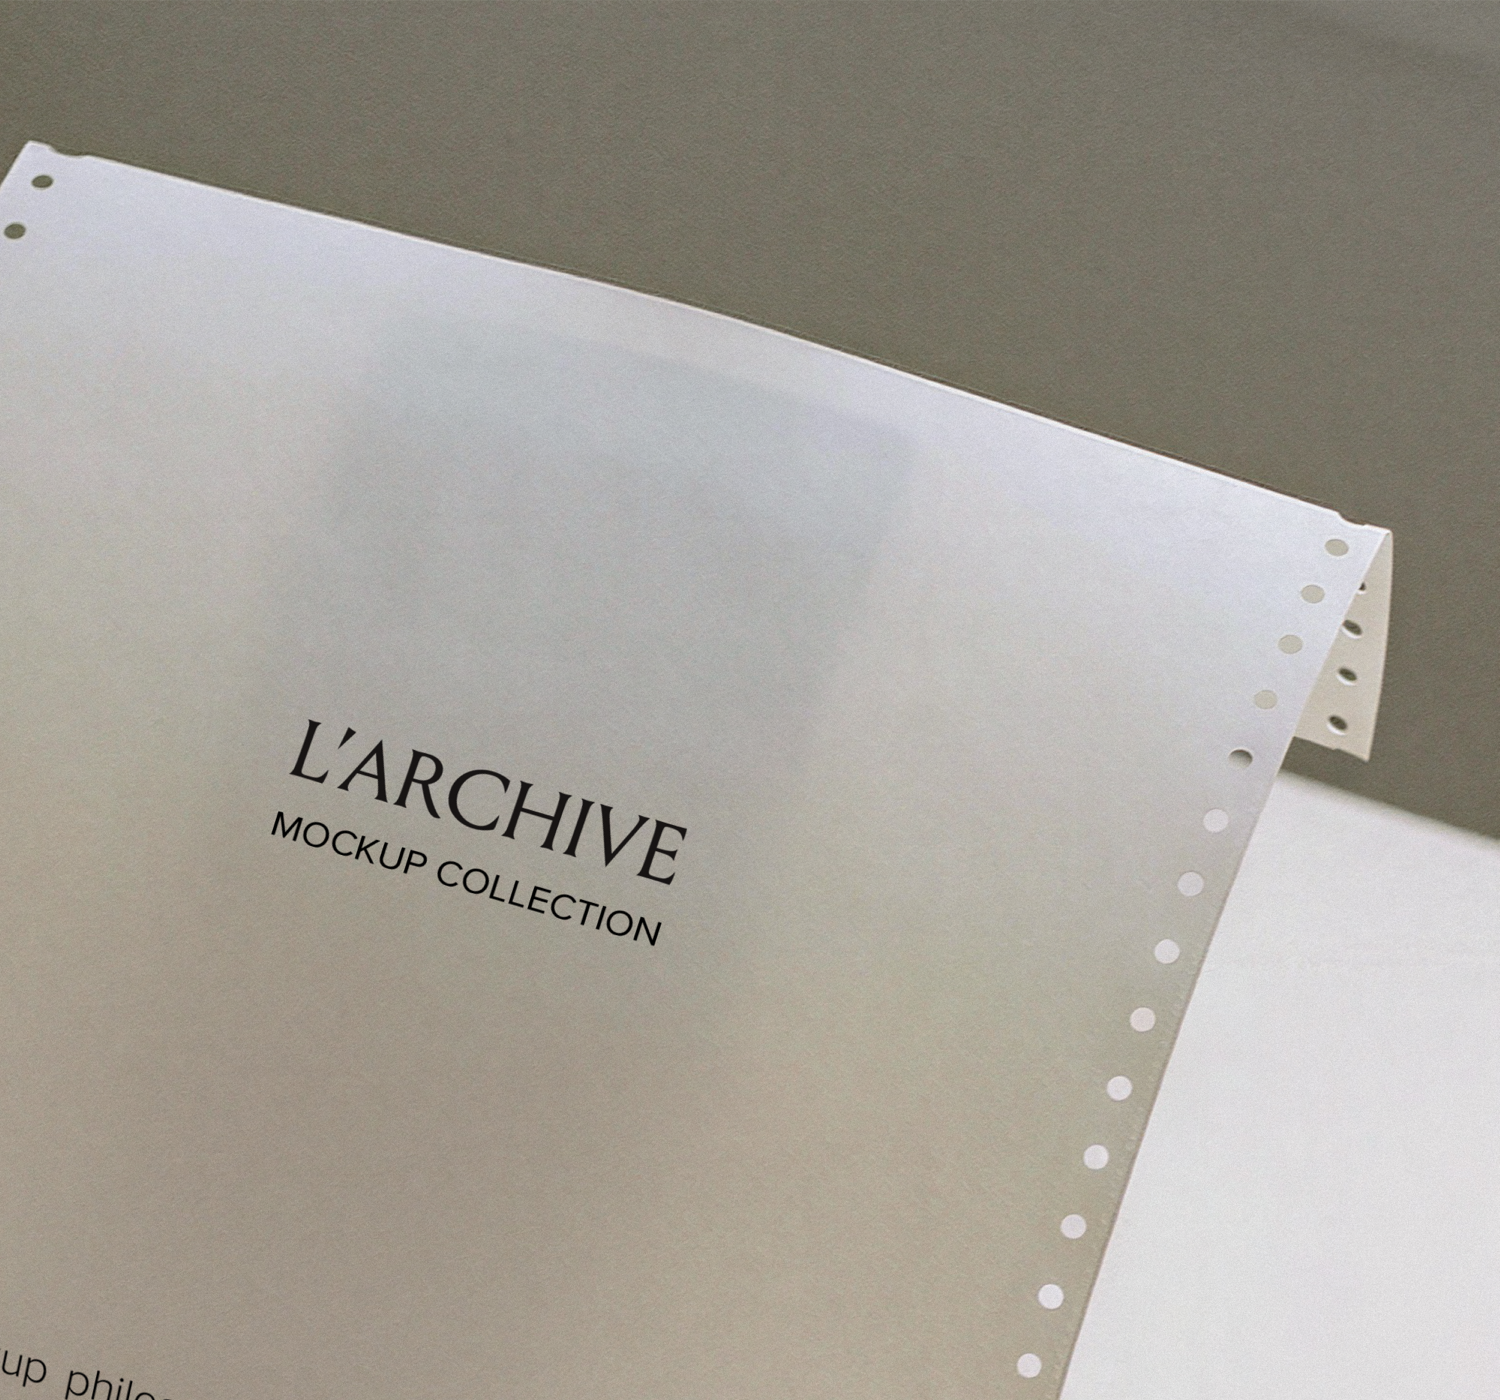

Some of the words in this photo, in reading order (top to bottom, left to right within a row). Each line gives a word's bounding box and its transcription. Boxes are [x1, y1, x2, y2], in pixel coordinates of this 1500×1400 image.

[288, 718, 688, 886] L'ARCHIVE
[270, 810, 428, 875] MOCKUP
[436, 860, 663, 947] COLLECTION
